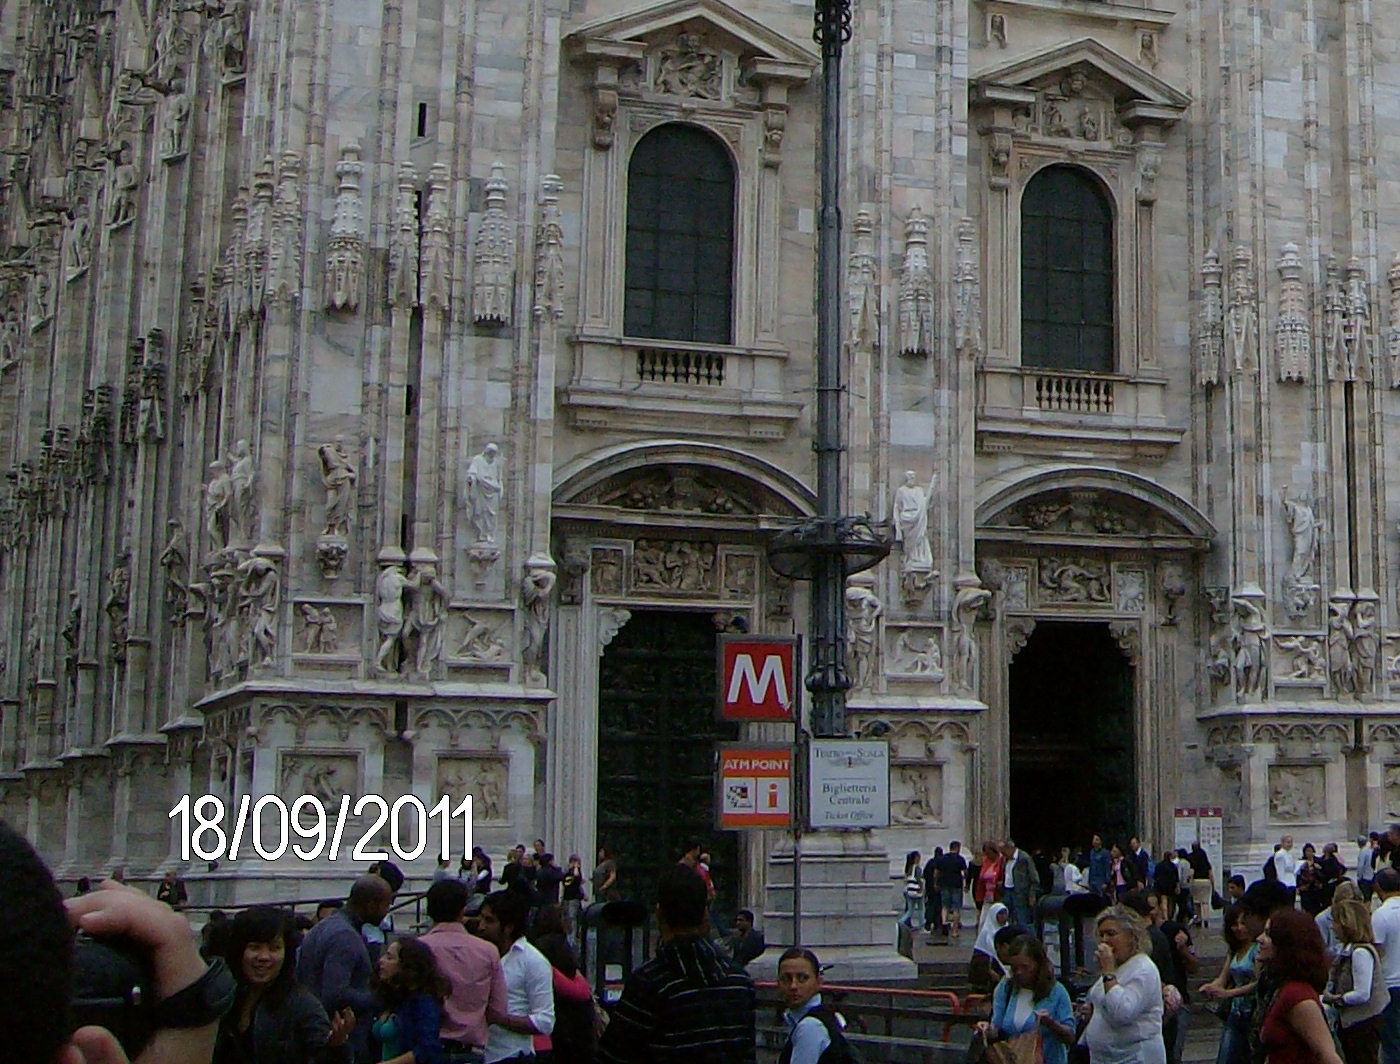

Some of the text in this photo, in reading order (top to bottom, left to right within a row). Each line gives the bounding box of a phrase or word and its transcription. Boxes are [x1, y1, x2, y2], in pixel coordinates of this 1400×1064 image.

[727, 654, 791, 705] M
[723, 759, 790, 770] ATM POINT
[822, 783, 877, 795] Biglietteria
[829, 794, 871, 805] Centrale
